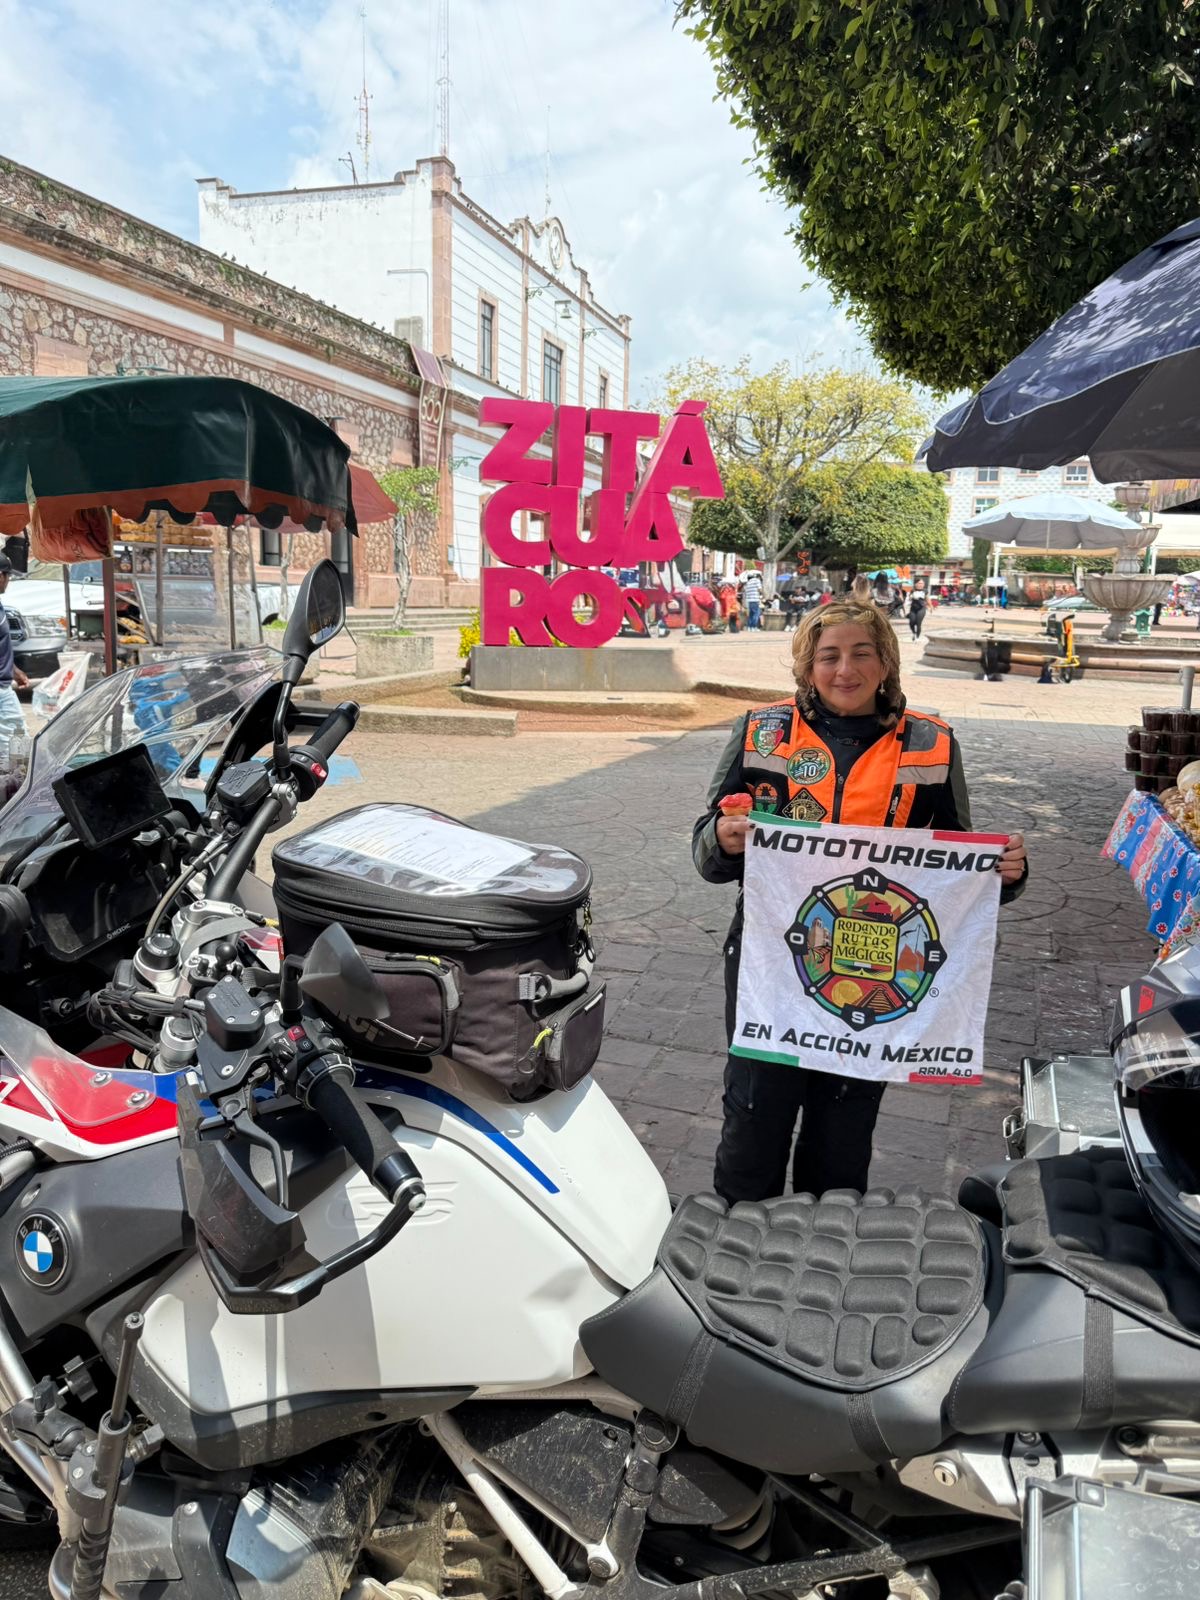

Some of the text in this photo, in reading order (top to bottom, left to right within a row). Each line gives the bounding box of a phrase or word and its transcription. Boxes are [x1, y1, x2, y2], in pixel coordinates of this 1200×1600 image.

[479, 396, 726, 499] ZITÁ
[480, 567, 623, 648] RO
[802, 764, 817, 777] 10
[790, 805, 807, 821] 10
[752, 827, 1001, 873] MOTOTURISMO
[862, 874, 879, 888] N
[790, 932, 804, 945] O
[928, 951, 940, 963] E
[851, 1011, 866, 1024] S
[742, 1021, 974, 1064] EN ACCIÓN MÉXICO
[918, 1066, 973, 1078] RRM 4.0
[19, 1219, 60, 1244] BMW
